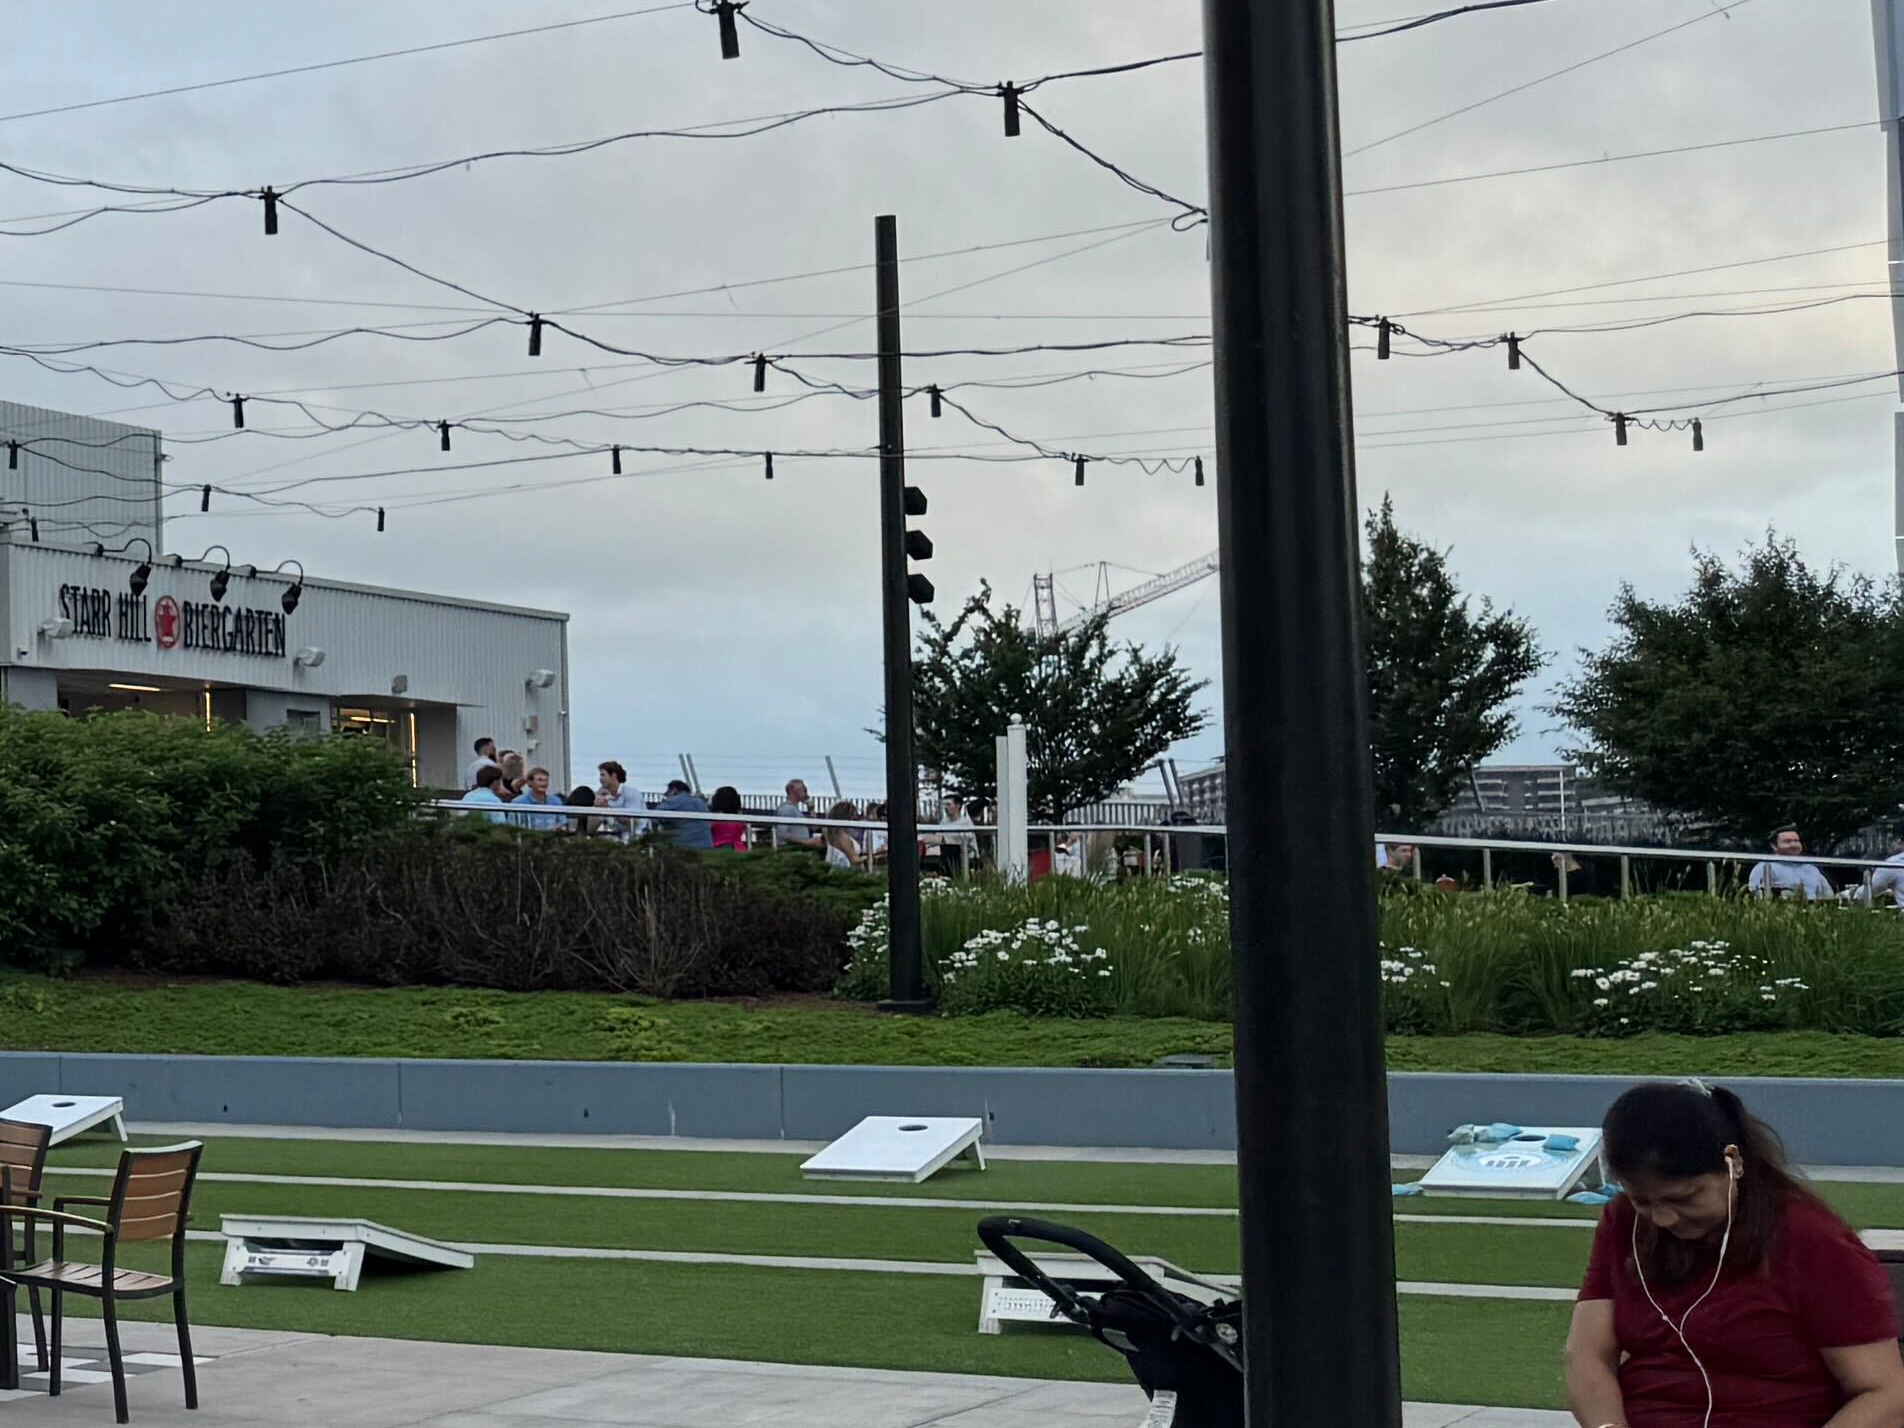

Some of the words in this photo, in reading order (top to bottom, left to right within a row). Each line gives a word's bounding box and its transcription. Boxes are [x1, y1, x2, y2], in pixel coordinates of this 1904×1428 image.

[59, 583, 112, 638] STARR
[118, 591, 152, 642] HILL
[183, 600, 287, 659] BIERGARTEN
